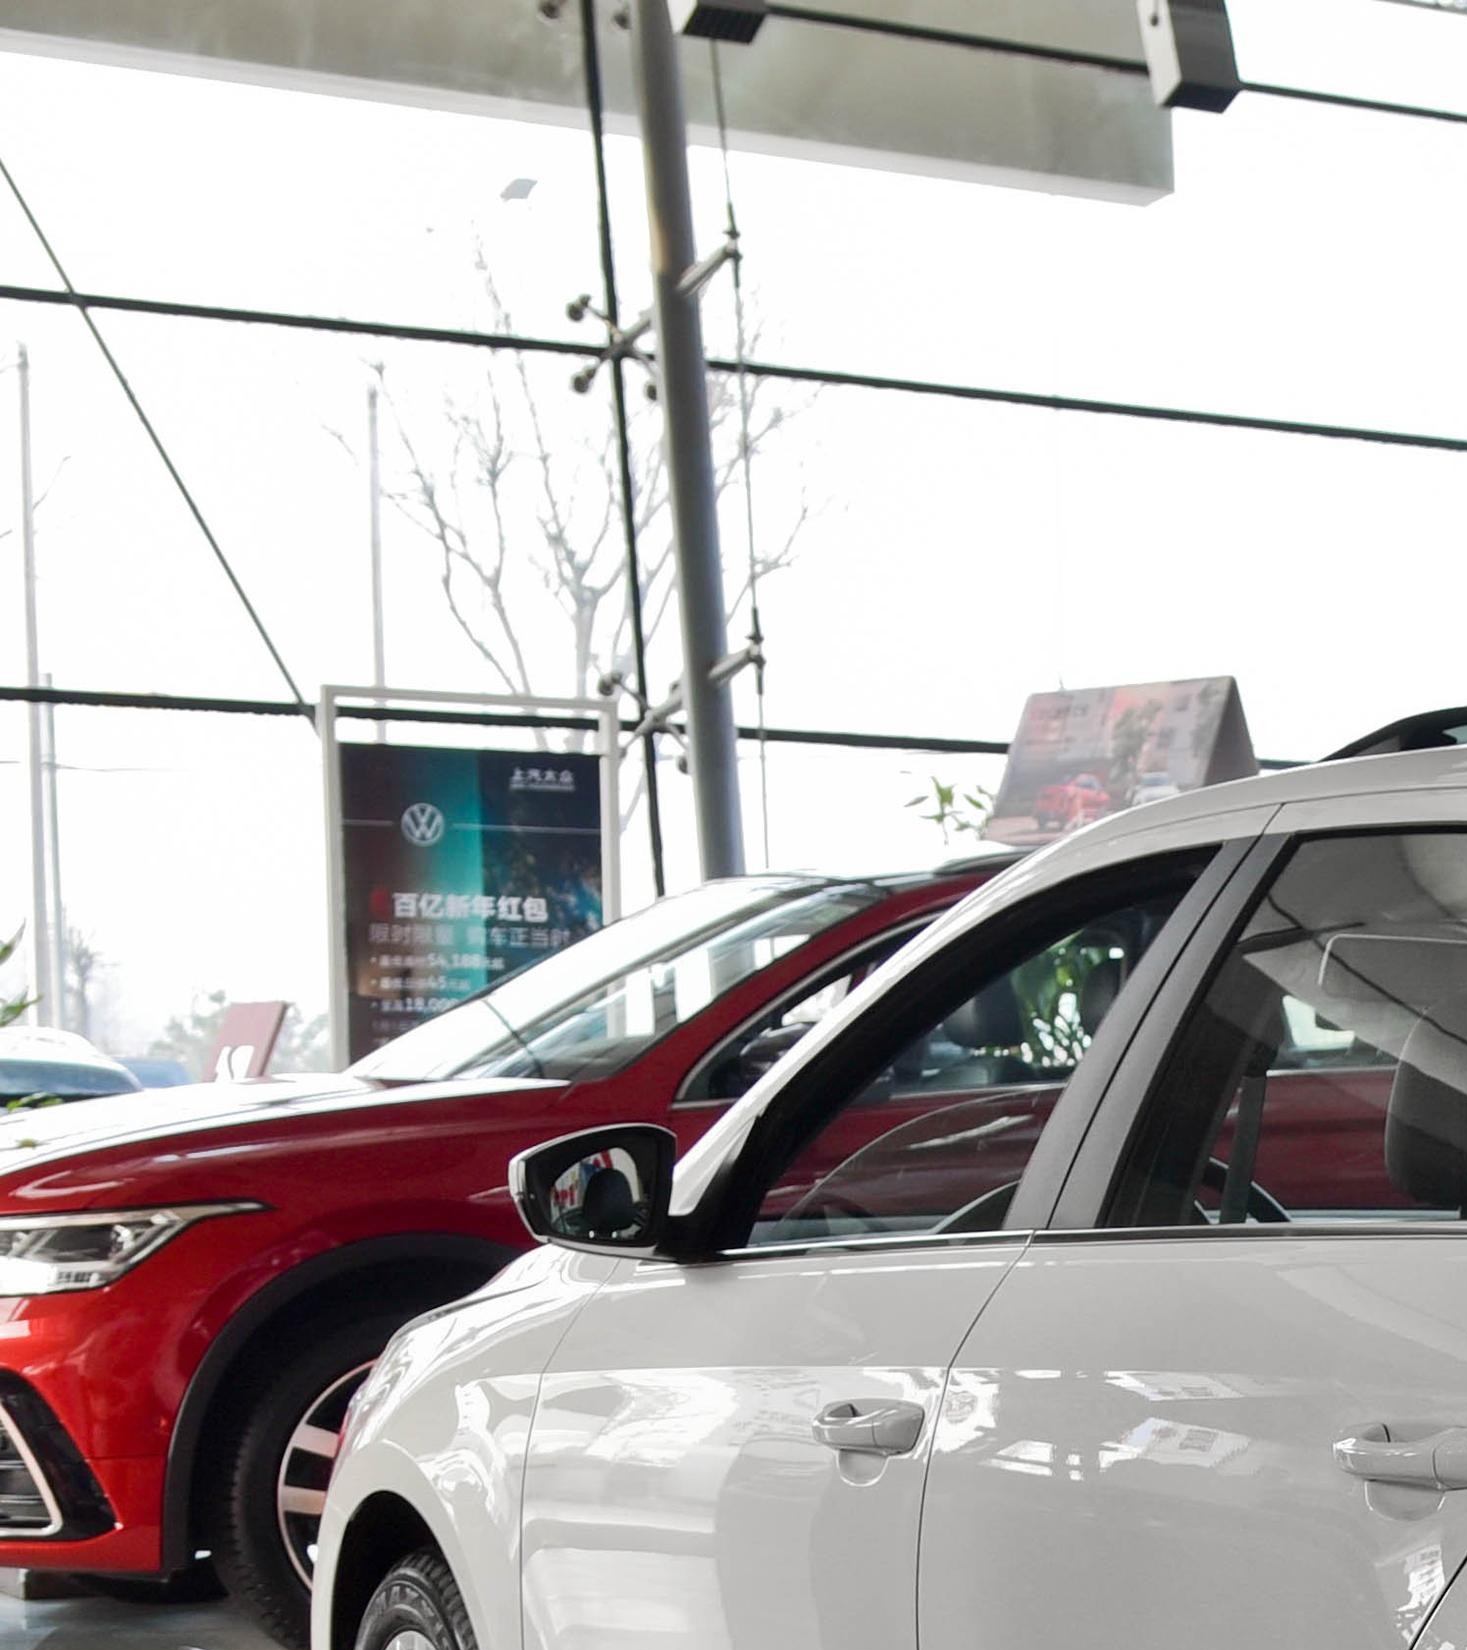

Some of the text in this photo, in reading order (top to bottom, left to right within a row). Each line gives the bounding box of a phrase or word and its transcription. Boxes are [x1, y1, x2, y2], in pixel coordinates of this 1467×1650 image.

[393, 892, 549, 923] 百亿新年红包
